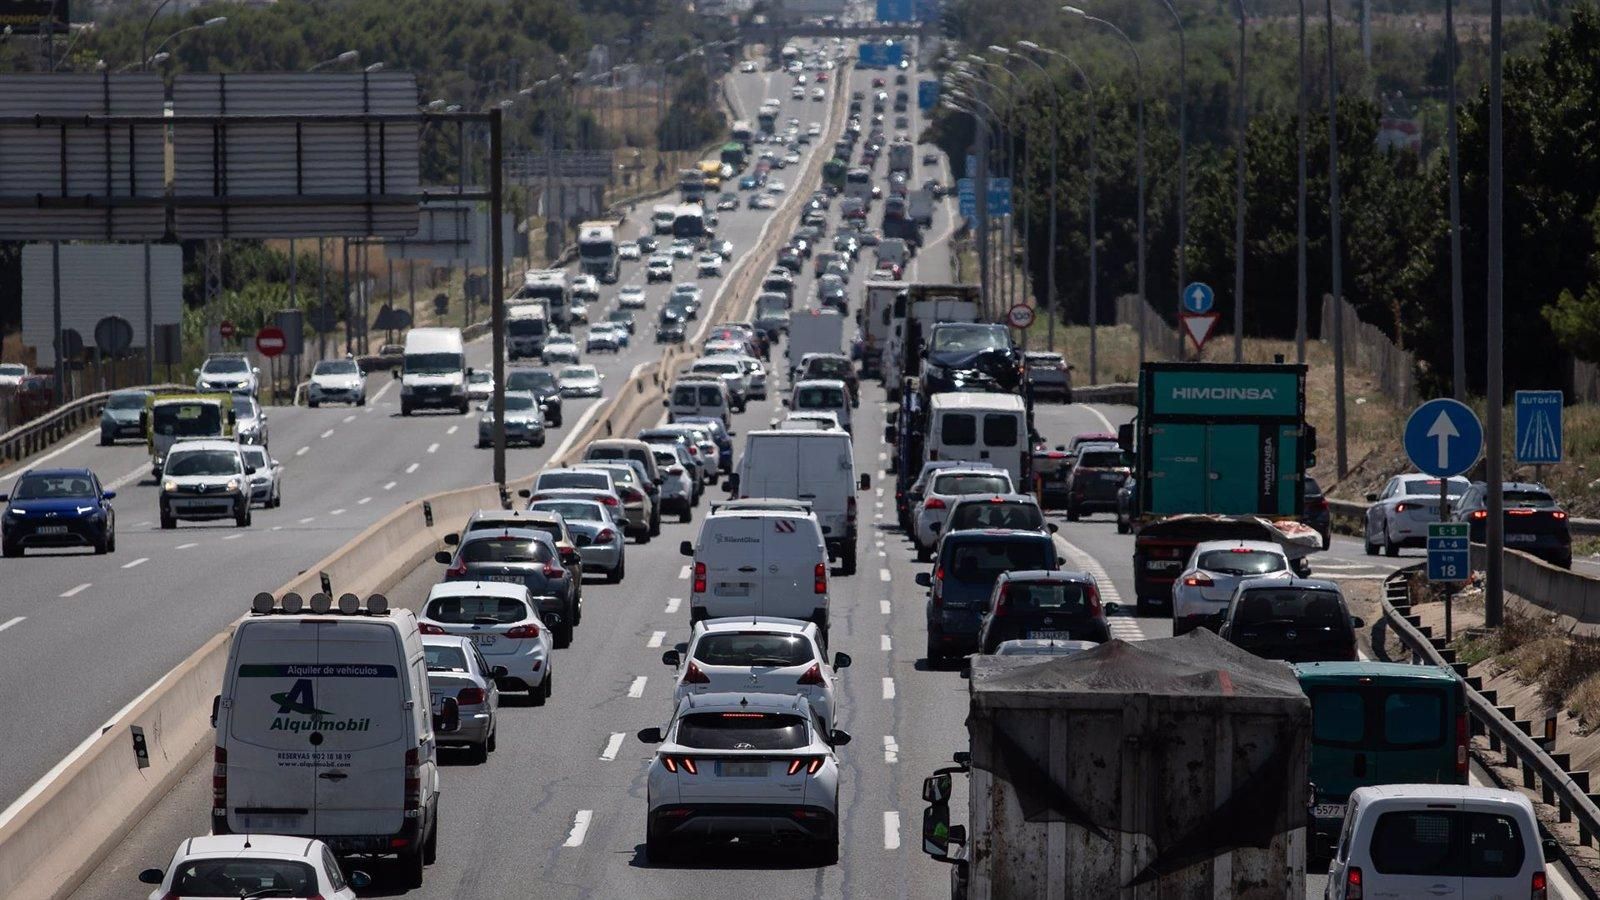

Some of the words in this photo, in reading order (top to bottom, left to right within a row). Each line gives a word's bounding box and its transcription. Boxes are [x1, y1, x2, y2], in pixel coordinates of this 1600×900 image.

[1172, 387, 1275, 400] HIMOINSA
[1264, 437, 1272, 495] HIMOINSA
[1441, 553, 1455, 561] km
[1440, 564, 1457, 577] 18
[481, 635, 497, 643] LCS
[287, 665, 320, 675] Alquiler
[323, 665, 334, 674] de
[270, 717, 370, 733] Alquimobil
[277, 752, 310, 760] RESERVAS
[312, 752, 325, 760] 902
[327, 752, 334, 760] 18
[336, 752, 343, 760] 18
[344, 752, 352, 760] 19
[1316, 805, 1340, 815] 5577
